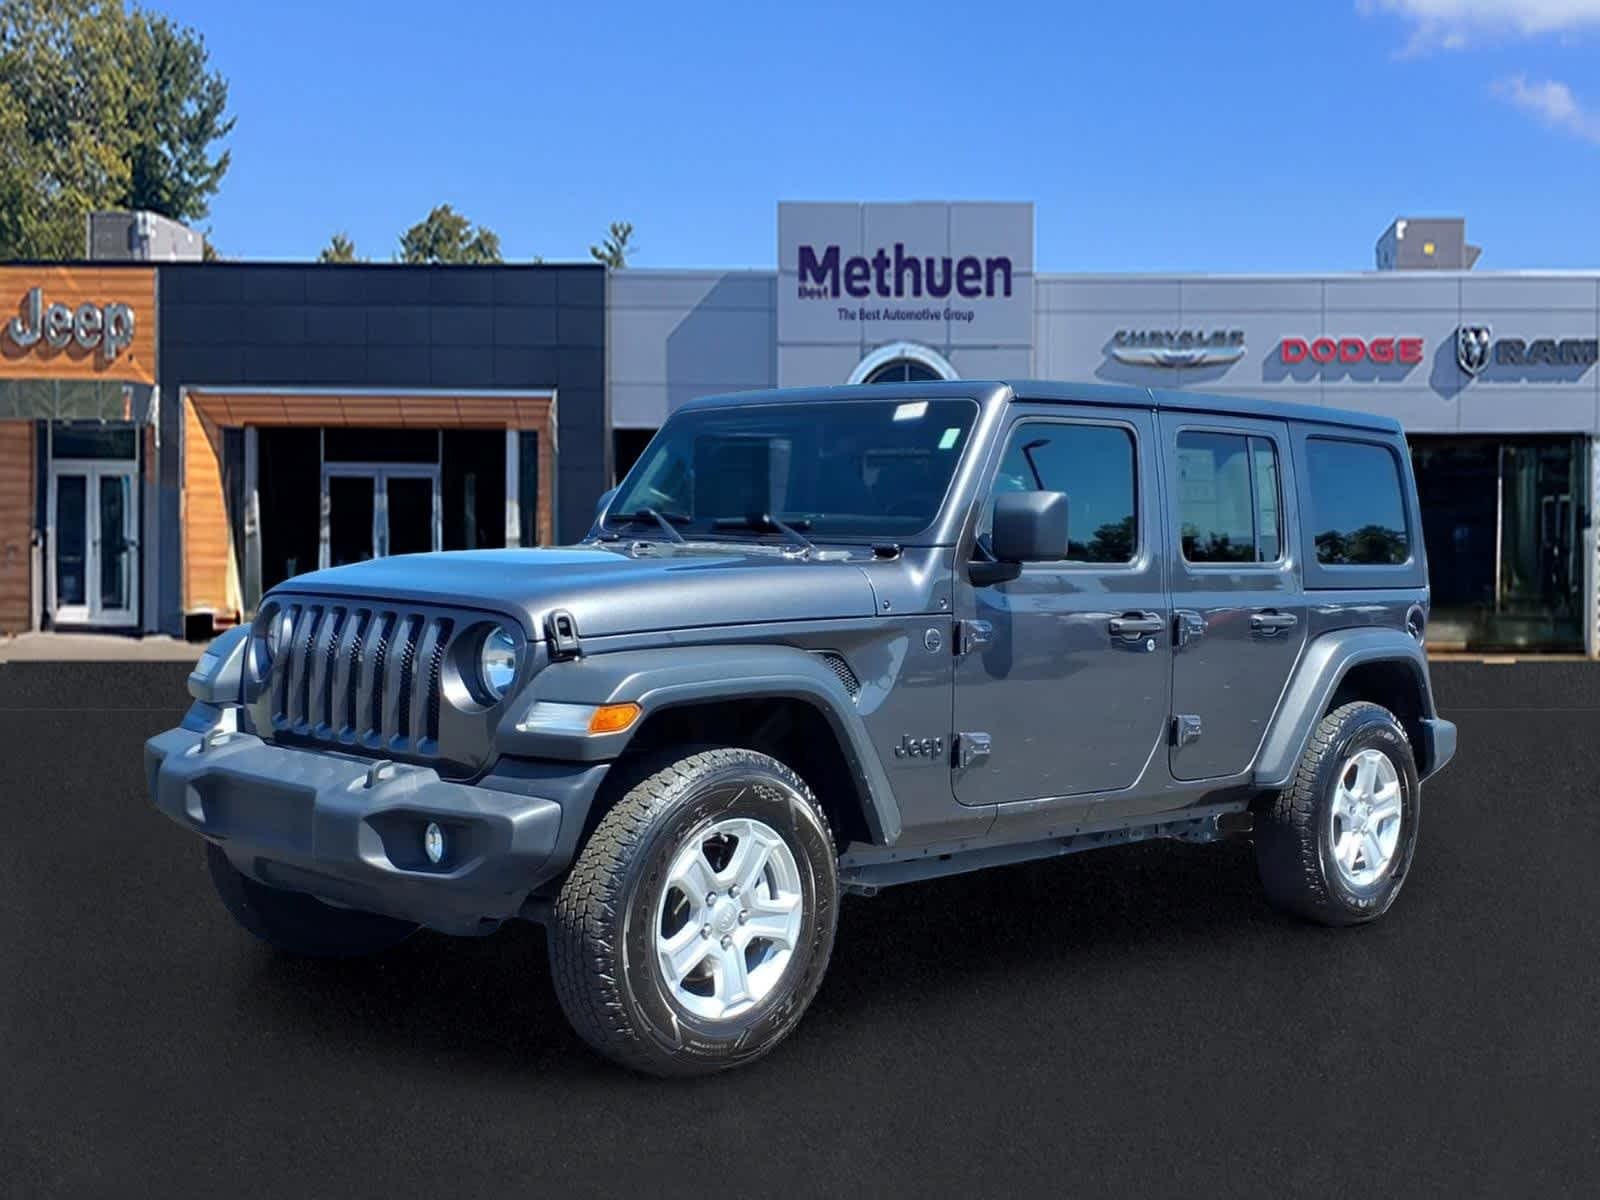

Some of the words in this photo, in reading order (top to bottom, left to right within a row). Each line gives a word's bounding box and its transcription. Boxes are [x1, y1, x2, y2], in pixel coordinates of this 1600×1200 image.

[798, 243, 1012, 298] Methuen
[798, 286, 828, 299] Best
[8, 288, 134, 360] Jeep
[838, 308, 857, 320] The
[859, 308, 880, 320] Best
[882, 307, 941, 321] Automotive
[943, 307, 974, 323] Group
[1114, 330, 1245, 345] CHRYSLER
[1281, 338, 1424, 363] DODGE
[1494, 339, 1599, 364] RAM
[895, 734, 943, 760] Jeep
